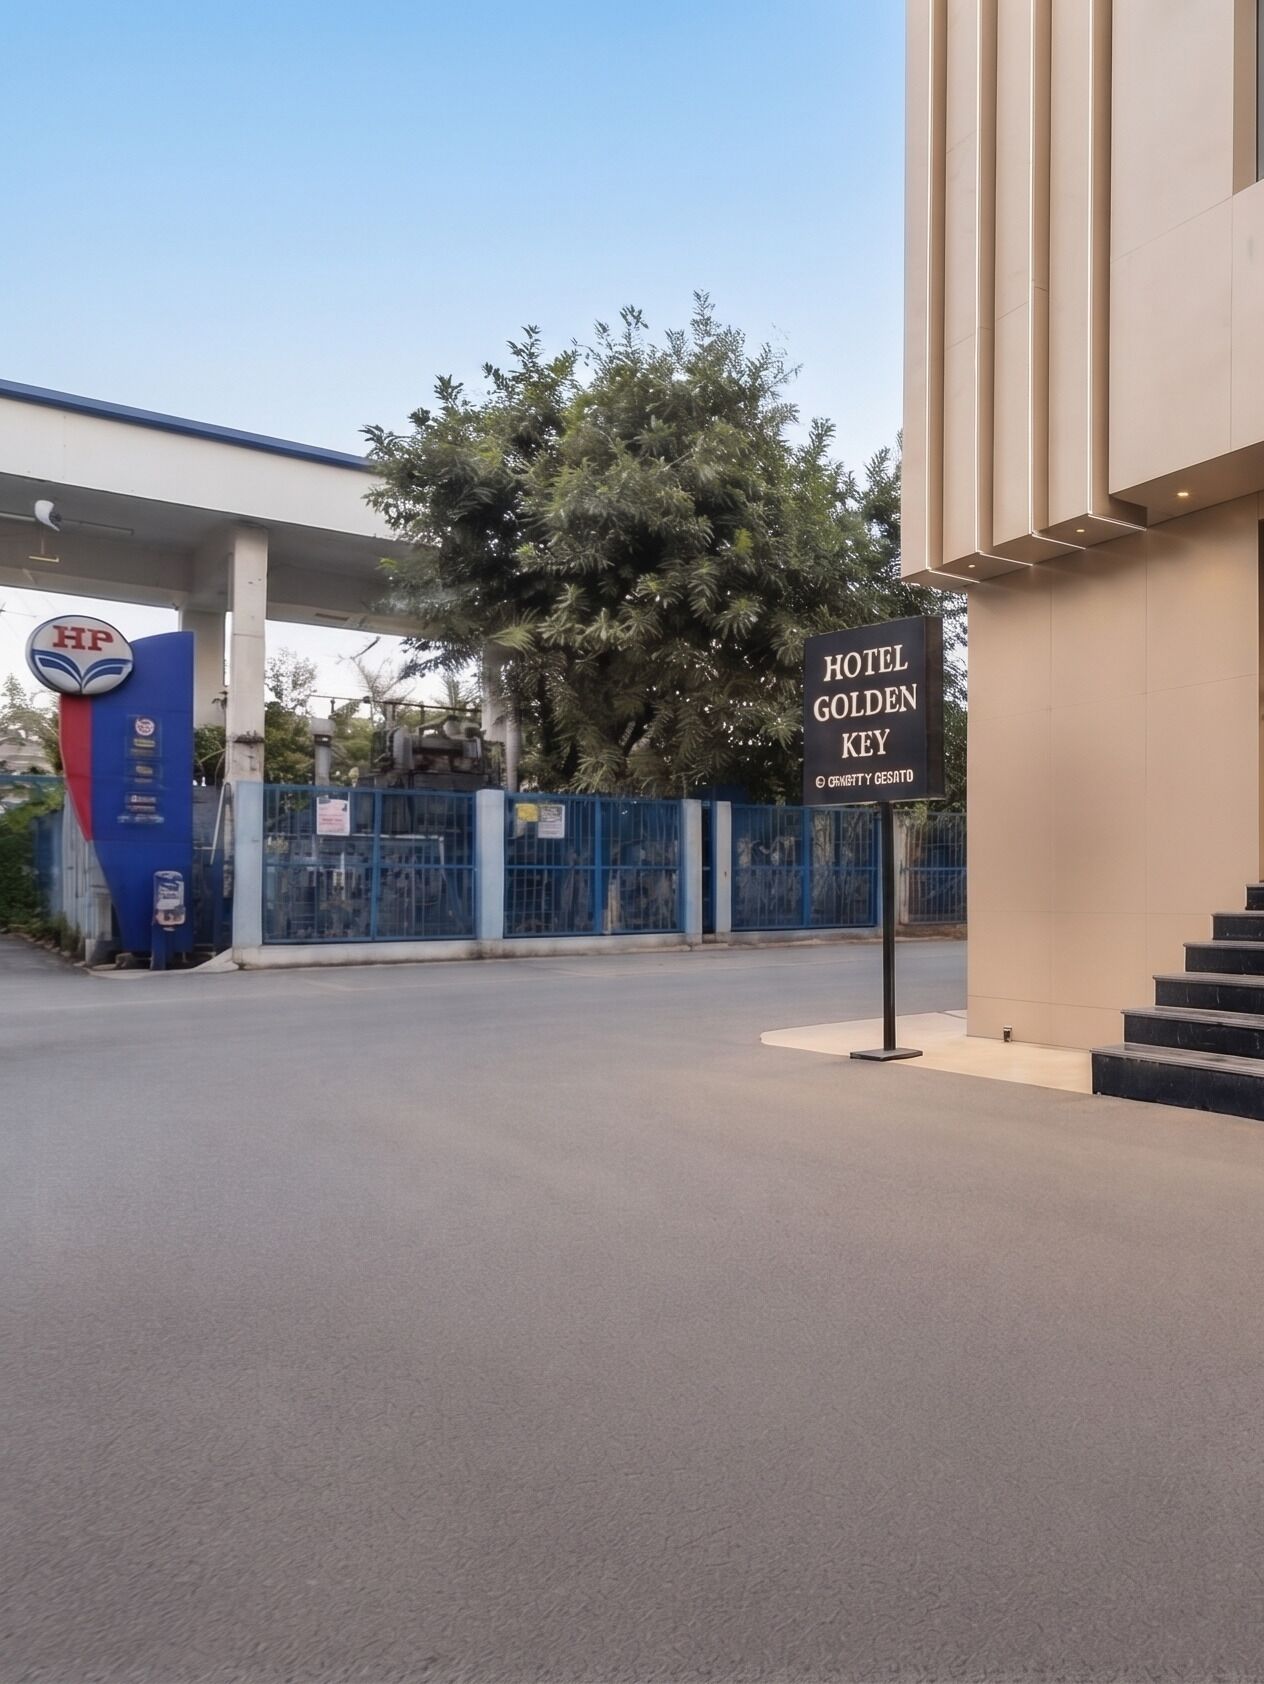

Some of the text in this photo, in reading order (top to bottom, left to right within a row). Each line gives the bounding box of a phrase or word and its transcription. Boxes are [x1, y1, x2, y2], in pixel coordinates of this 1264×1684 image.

[53, 625, 113, 651] HP
[823, 645, 908, 682] HOTEL
[813, 683, 918, 722] GOLDEN
[841, 729, 890, 758] KEY
